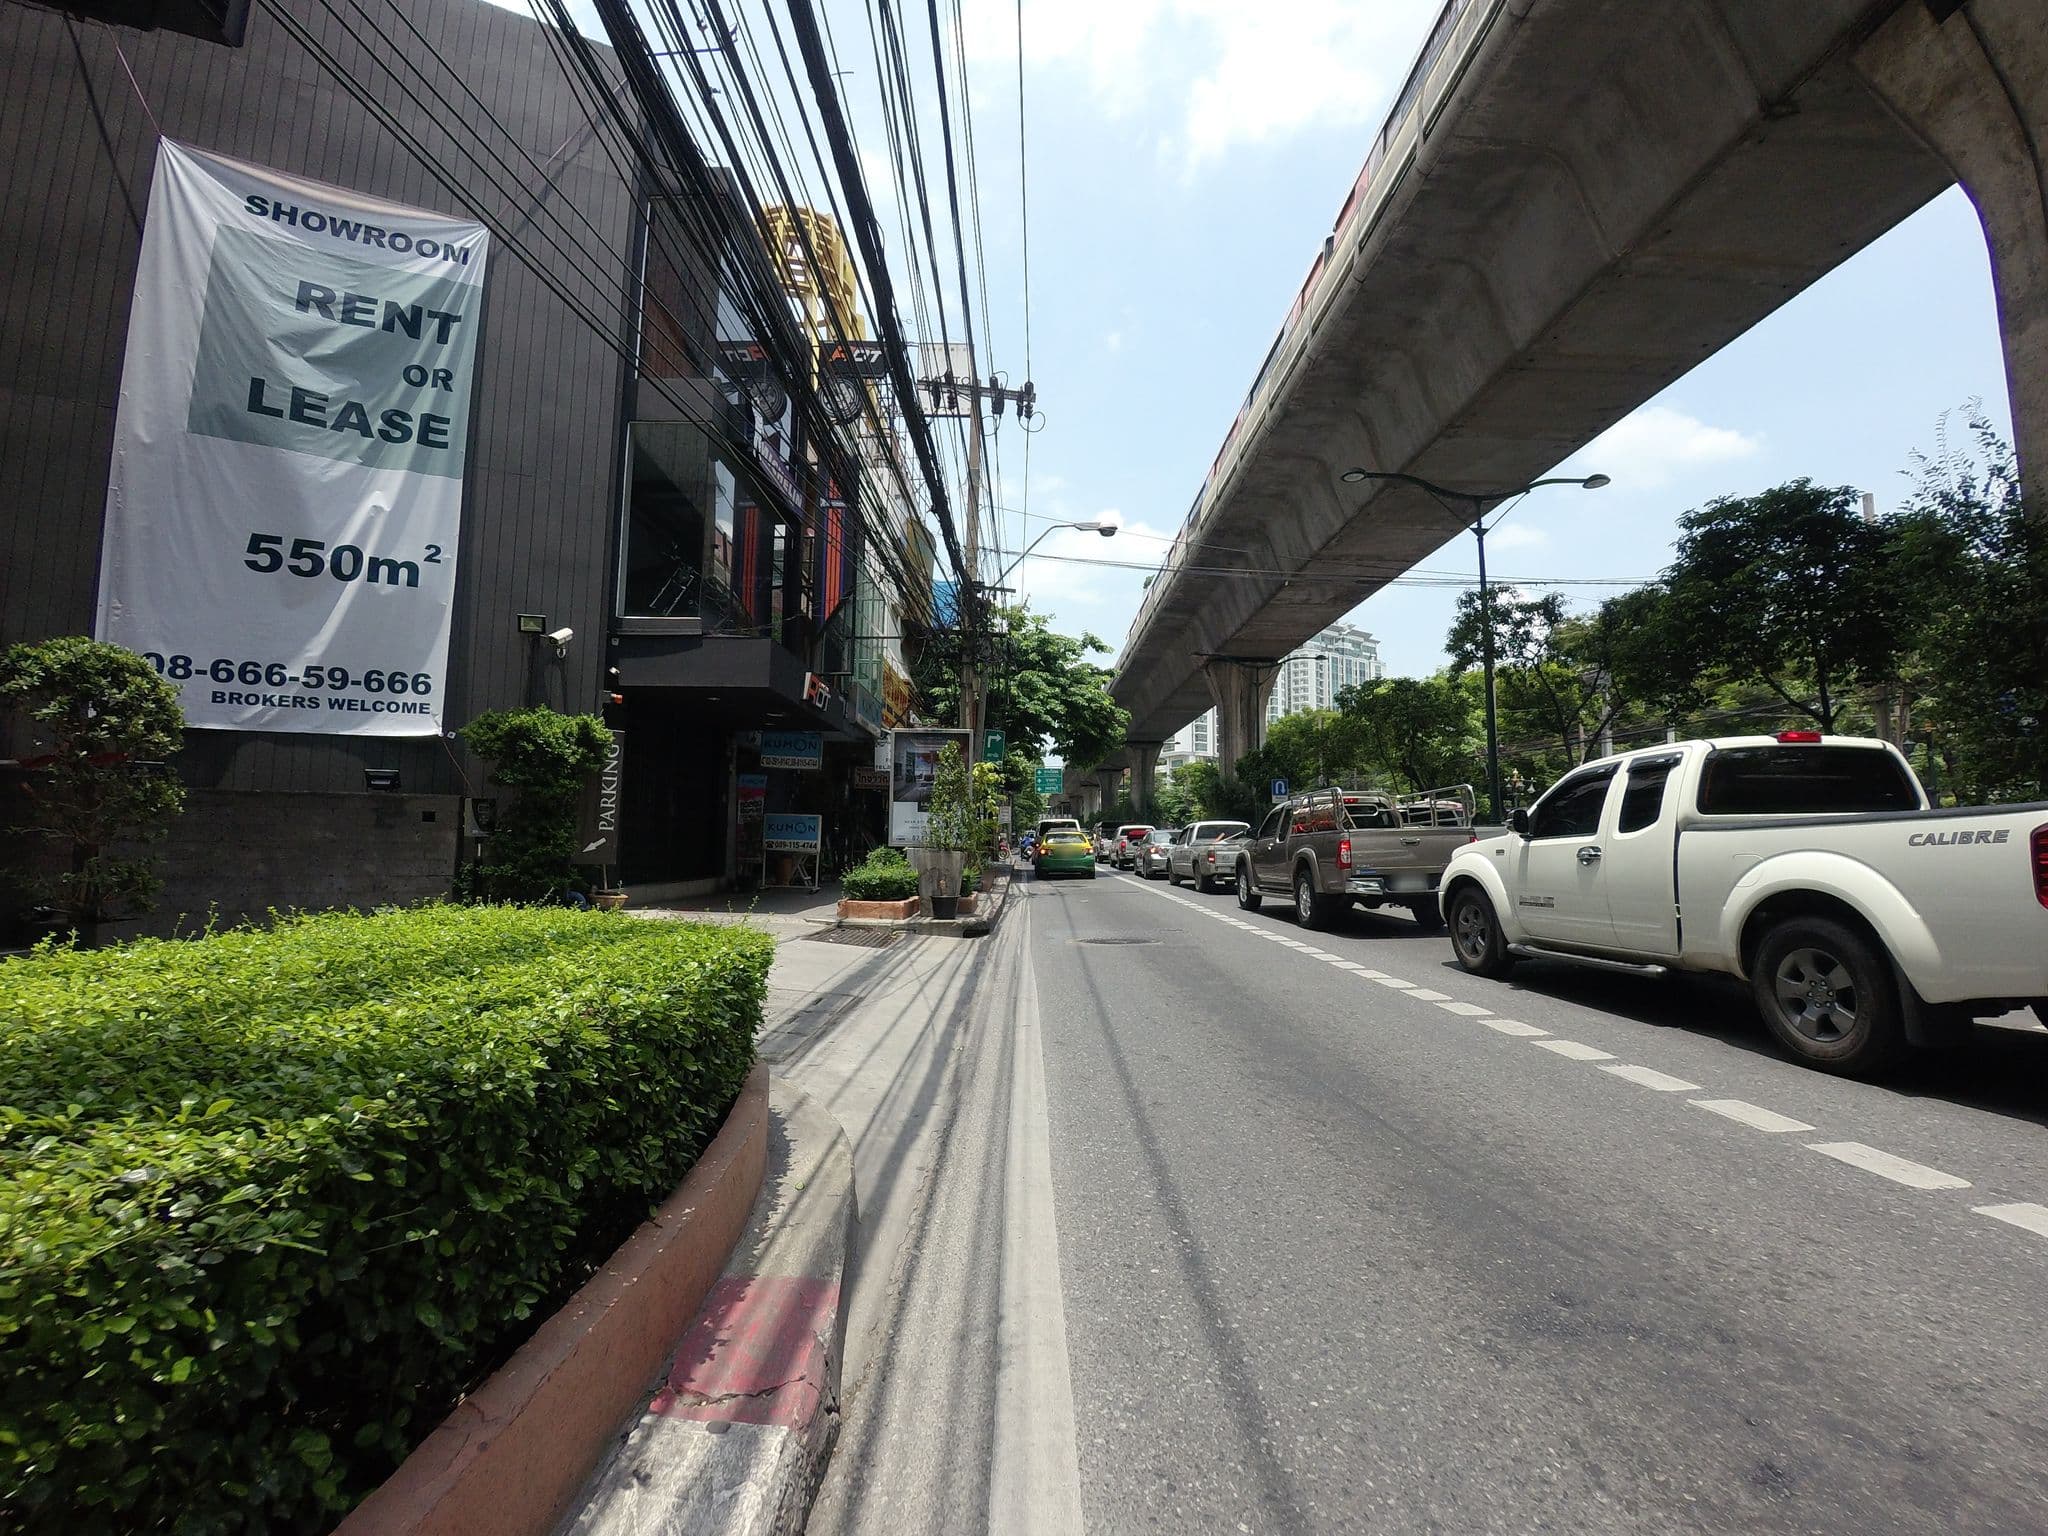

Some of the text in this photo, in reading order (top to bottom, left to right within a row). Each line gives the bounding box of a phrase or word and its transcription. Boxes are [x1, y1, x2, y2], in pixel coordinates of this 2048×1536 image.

[244, 195, 469, 266] SHOWROOM
[296, 279, 462, 346] RENT
[402, 364, 454, 393] OR
[246, 377, 451, 450] LEASE
[211, 690, 431, 715] BROKERS WELCOME
[764, 739, 817, 751] KUMON
[599, 743, 620, 831] PARKING
[767, 822, 816, 834] KUMON
[1908, 829, 2010, 846] CALIBRE
